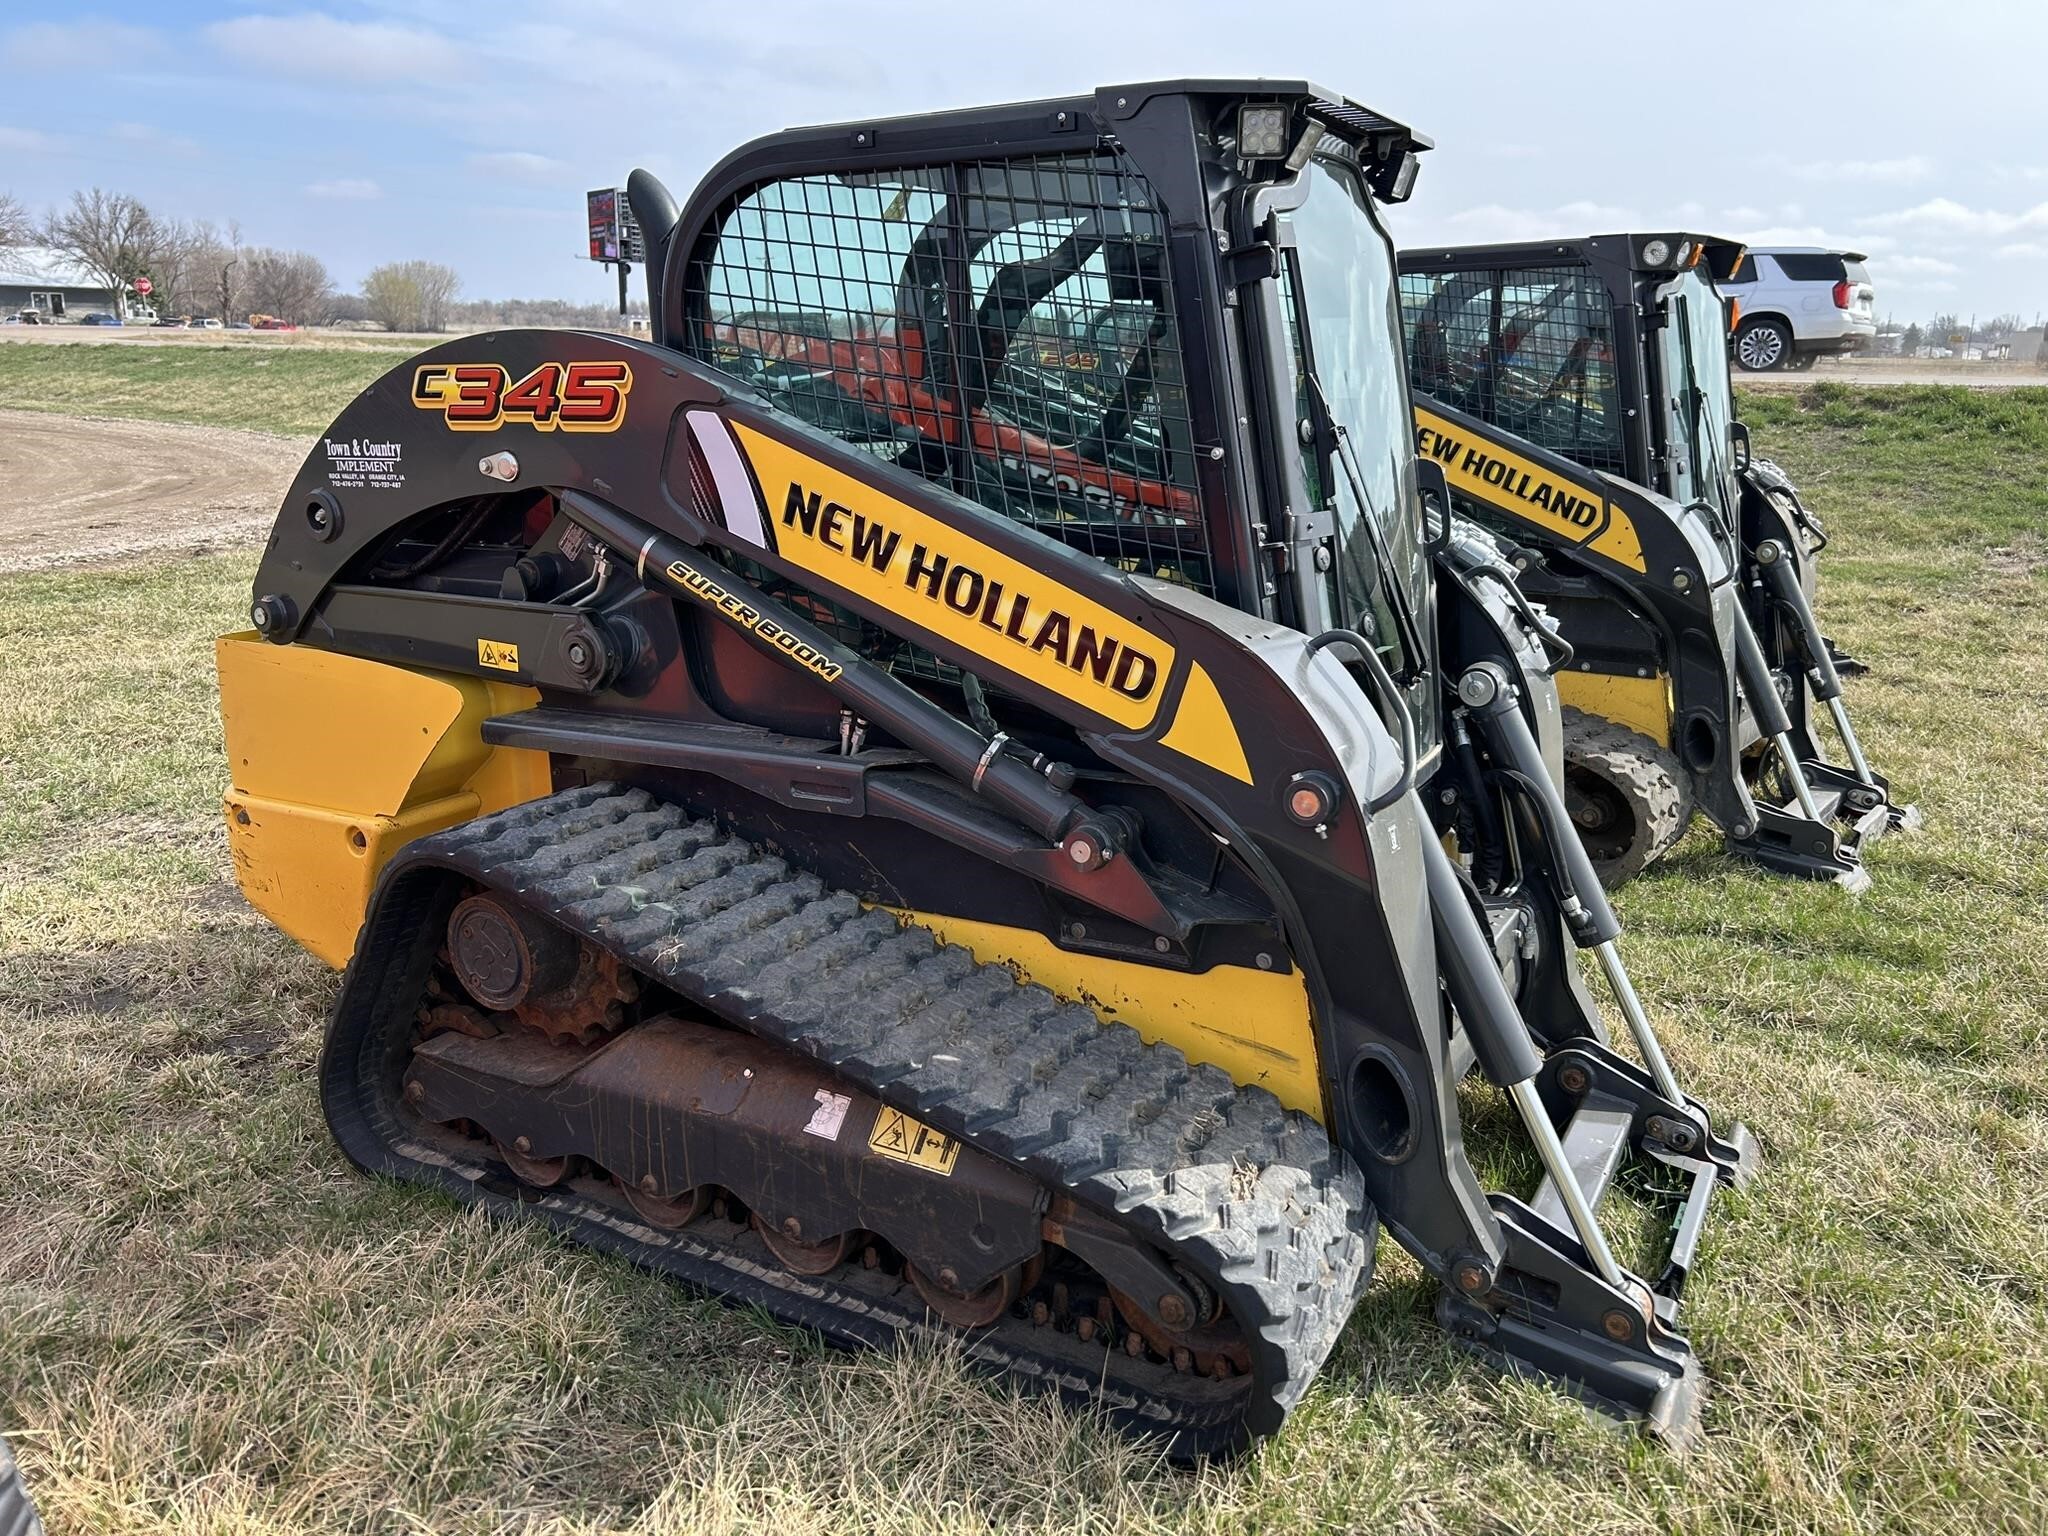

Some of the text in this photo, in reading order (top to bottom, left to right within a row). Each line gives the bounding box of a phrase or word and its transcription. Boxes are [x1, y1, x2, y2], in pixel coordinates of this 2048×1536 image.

[135, 282, 151, 290] STOP
[412, 363, 632, 431] C345
[324, 438, 402, 462] Town & Country
[335, 460, 395, 473] IMPLEMENT
[1416, 424, 1597, 529] EW HOLLAND
[666, 560, 844, 683] SUPER BOOM
[781, 480, 902, 577] NEW
[903, 543, 1159, 704] HOLLAND
